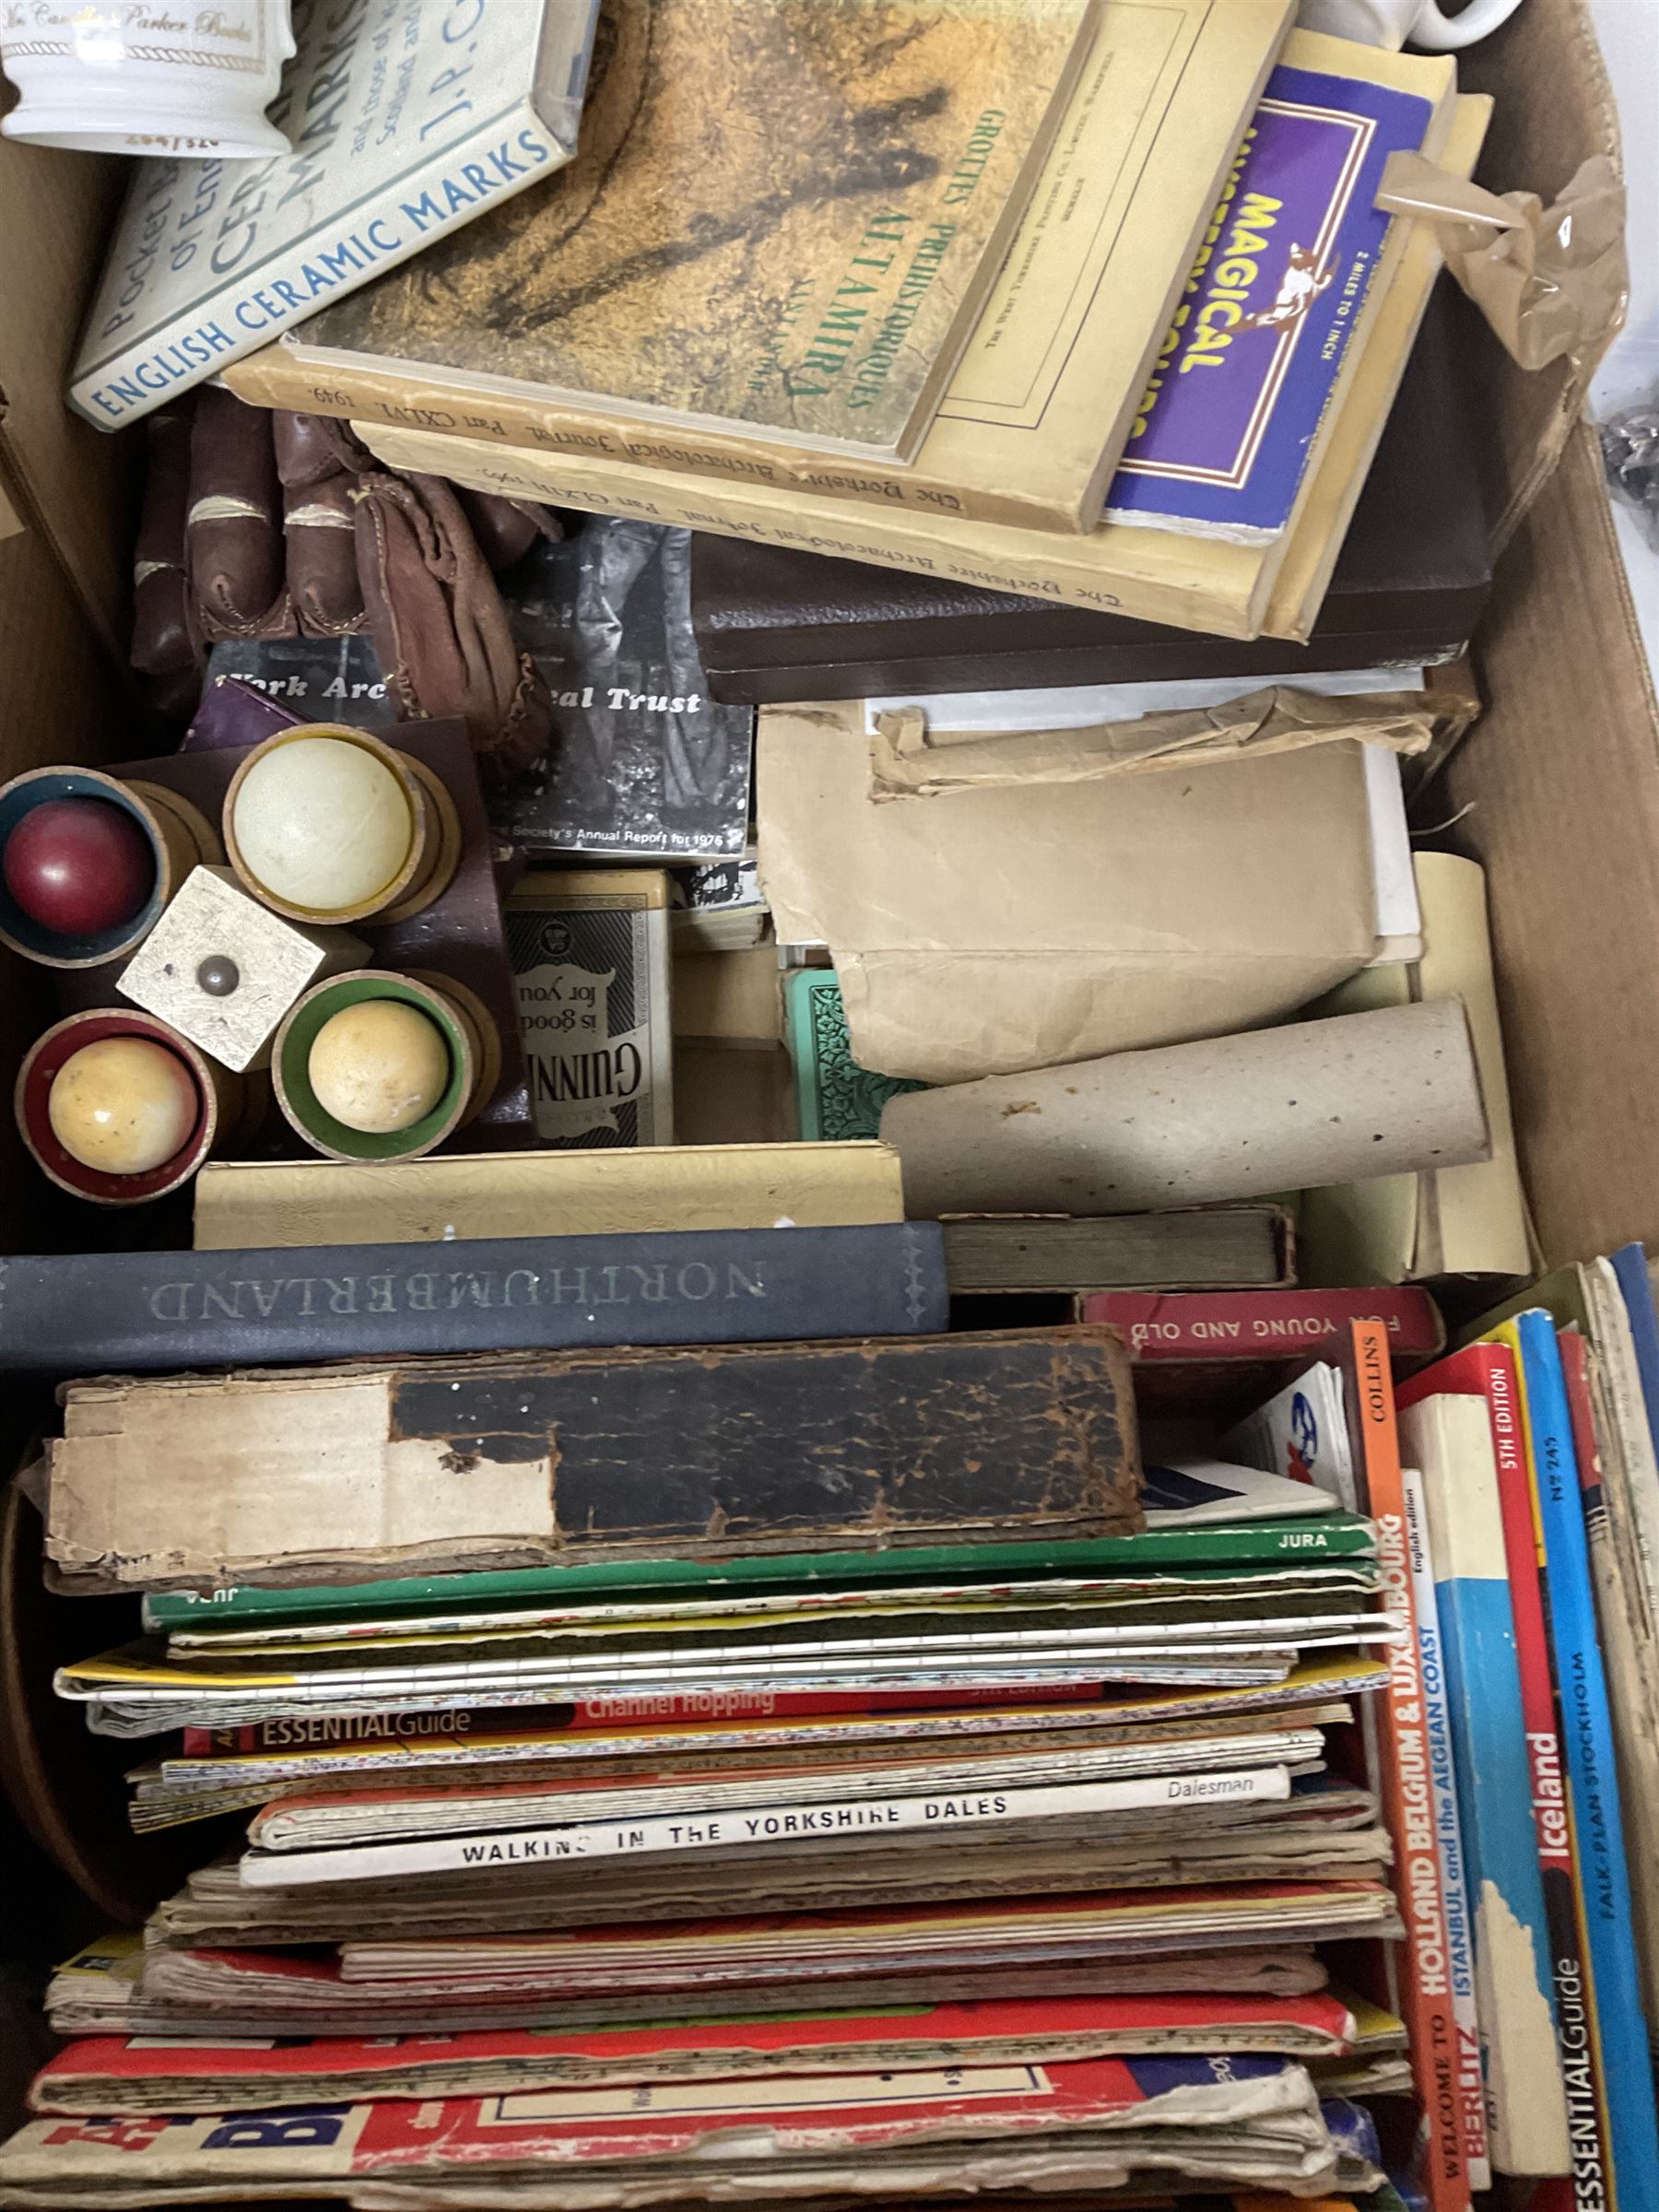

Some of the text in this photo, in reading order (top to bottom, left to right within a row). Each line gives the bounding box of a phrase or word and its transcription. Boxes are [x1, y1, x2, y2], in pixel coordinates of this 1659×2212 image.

[1357, 249, 1369, 260] 2
[91, 129, 550, 417] ENGLISH CERAMIC MARKS
[1179, 192, 1285, 375] MAGICAL
[1340, 260, 1367, 297] MILES
[794, 205, 913, 398] ALTAMIRA
[1335, 299, 1351, 317] TO
[1318, 326, 1343, 361] INCH
[305, 385, 352, 407] 1949.
[461, 414, 509, 437] Part
[615, 496, 662, 515] Part
[913, 488, 962, 511] The
[1075, 586, 1122, 608] The
[607, 688, 701, 713] Trust
[577, 829, 620, 841] Annual
[624, 830, 667, 845] Report
[671, 832, 689, 845] for
[692, 833, 724, 846] 1976
[520, 976, 596, 1007] for you
[521, 1009, 597, 1030] is good
[1131, 1323, 1181, 1339] OLD
[1192, 1321, 1241, 1337] AND
[1253, 1318, 1336, 1335] YOUNG
[1365, 1336, 1387, 1423] COLLINS
[1489, 1368, 1518, 1469] 5TH EDITION
[1278, 1531, 1327, 1549] JURA
[1406, 1488, 1423, 1573] English edition
[585, 1692, 775, 1720] Channel Hopping
[1395, 1702, 1421, 1723] &
[1571, 1651, 1599, 1786] STOCKHOLM
[1167, 1775, 1254, 1798] Dalesman
[1397, 1730, 1432, 1851] BELGIUM
[1526, 1733, 1570, 1856] Iceland
[618, 1831, 644, 1849] IN
[746, 1805, 900, 1837] YORKSHIRE
[924, 1796, 1007, 1821] DALES
[1419, 1627, 1471, 1996] ISTANBUL and the AEGEAN COAST
[1409, 1856, 1448, 1996] HOLLAND
[1431, 2014, 1446, 2049] TO
[1456, 2024, 1487, 2158] BERLITZ
[1435, 2055, 1461, 2178] WELCOME
